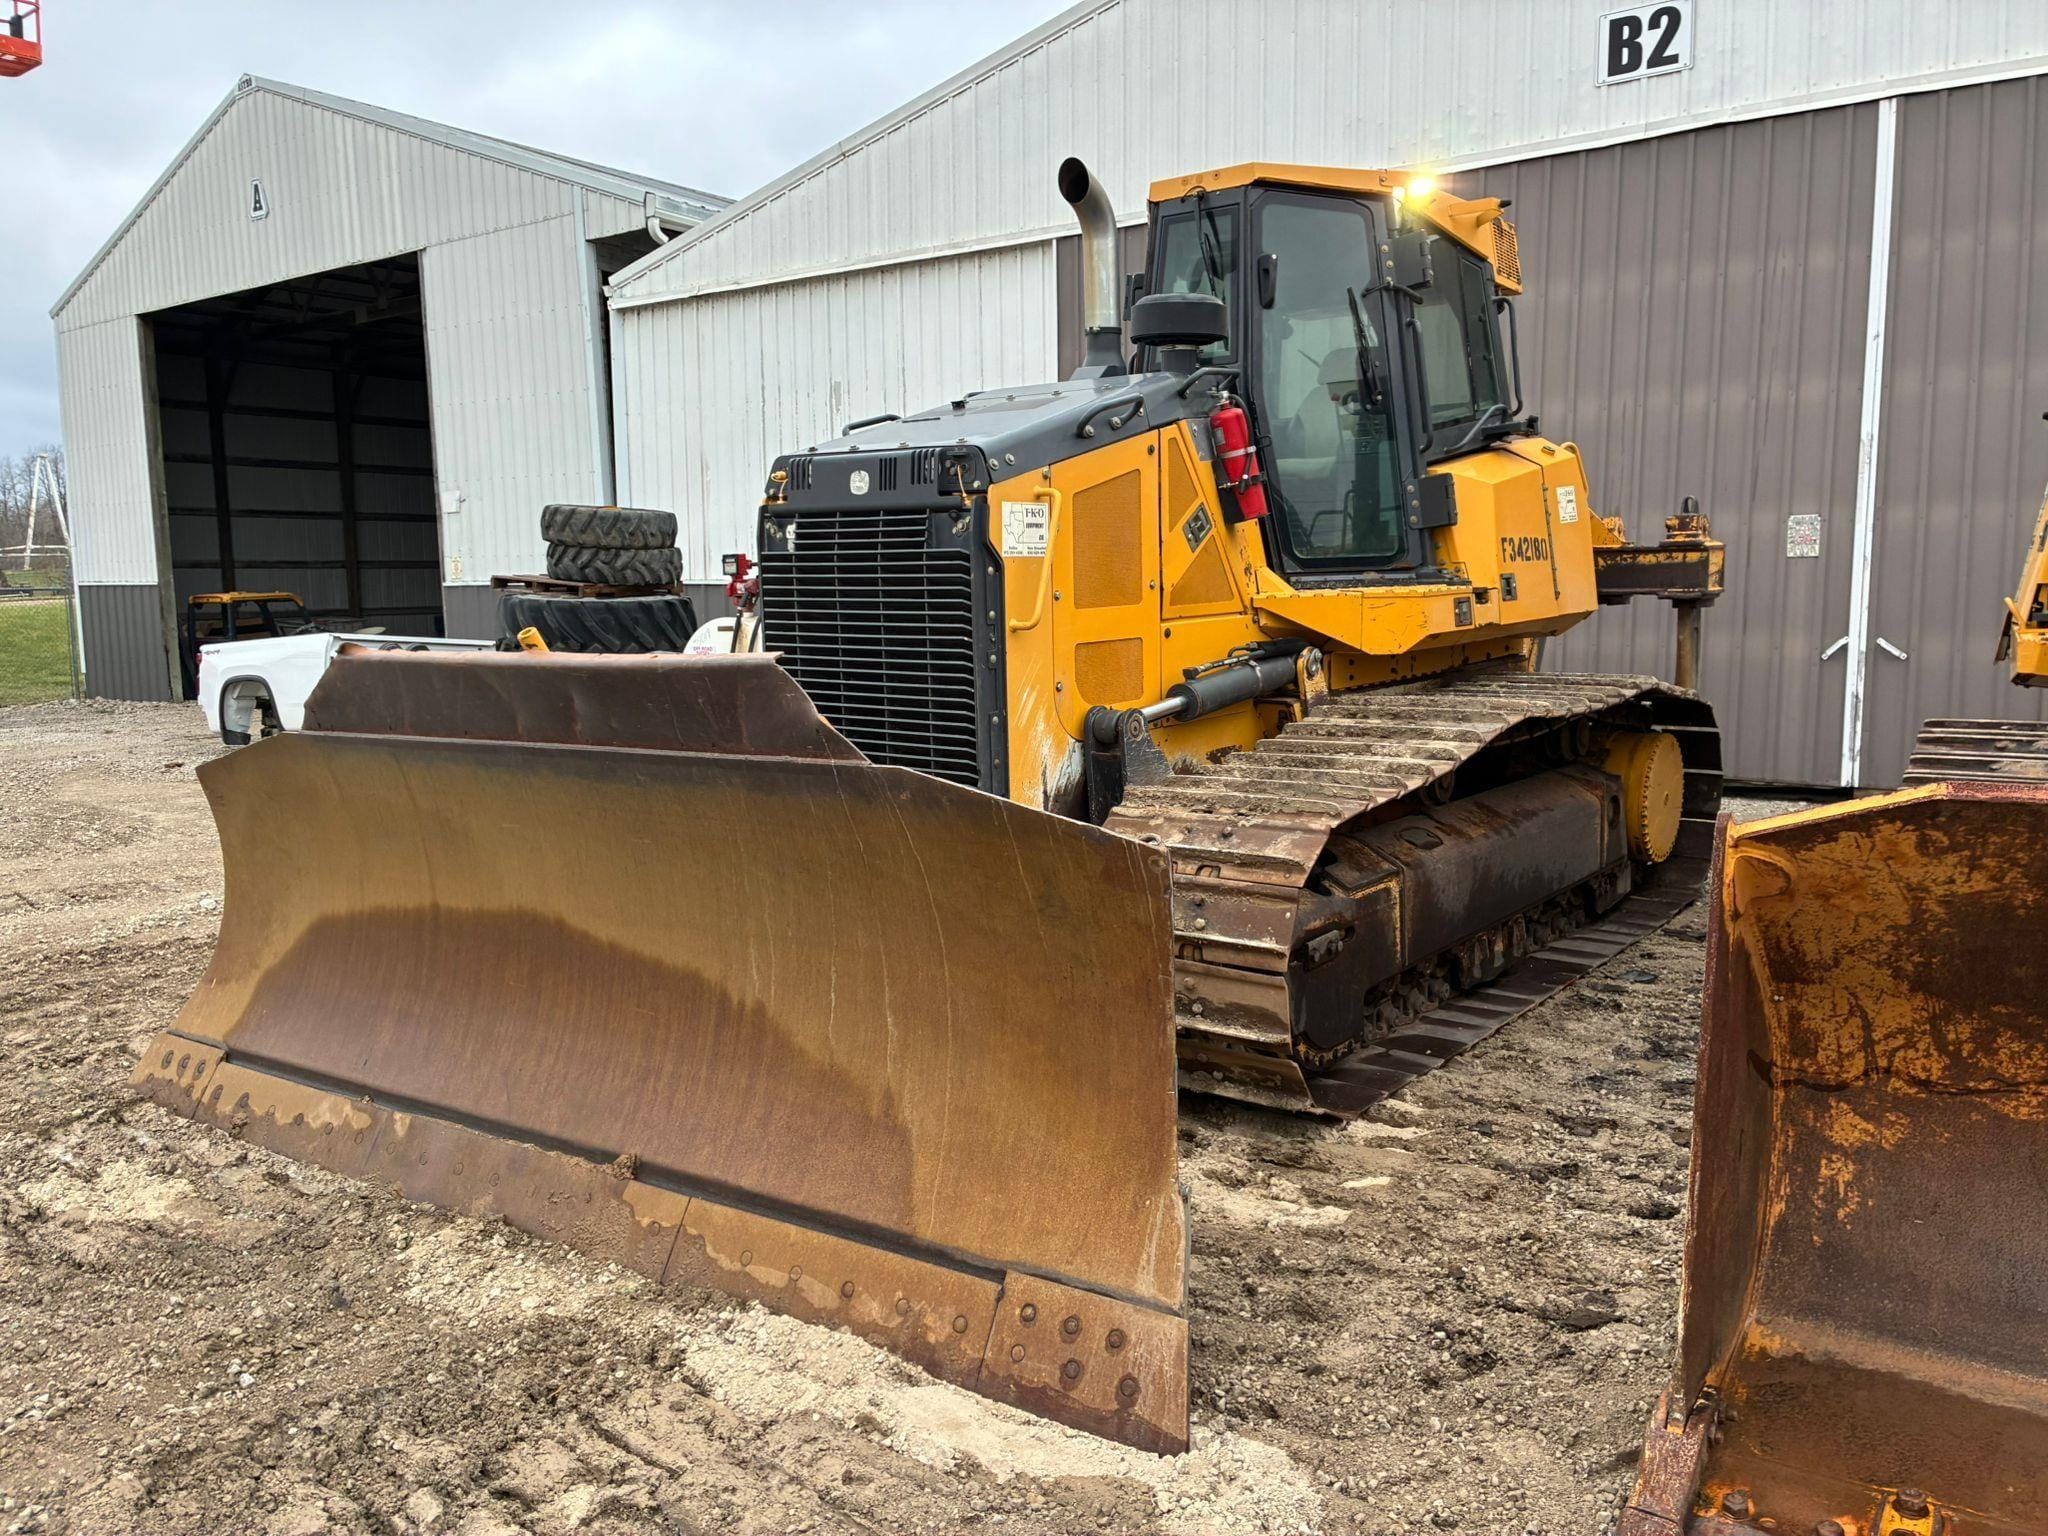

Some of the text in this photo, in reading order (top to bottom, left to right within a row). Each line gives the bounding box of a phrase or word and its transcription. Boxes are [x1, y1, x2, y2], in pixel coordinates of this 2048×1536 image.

[1607, 6, 1682, 77] B2
[252, 183, 263, 212] A
[1501, 537, 1548, 563] F342180
